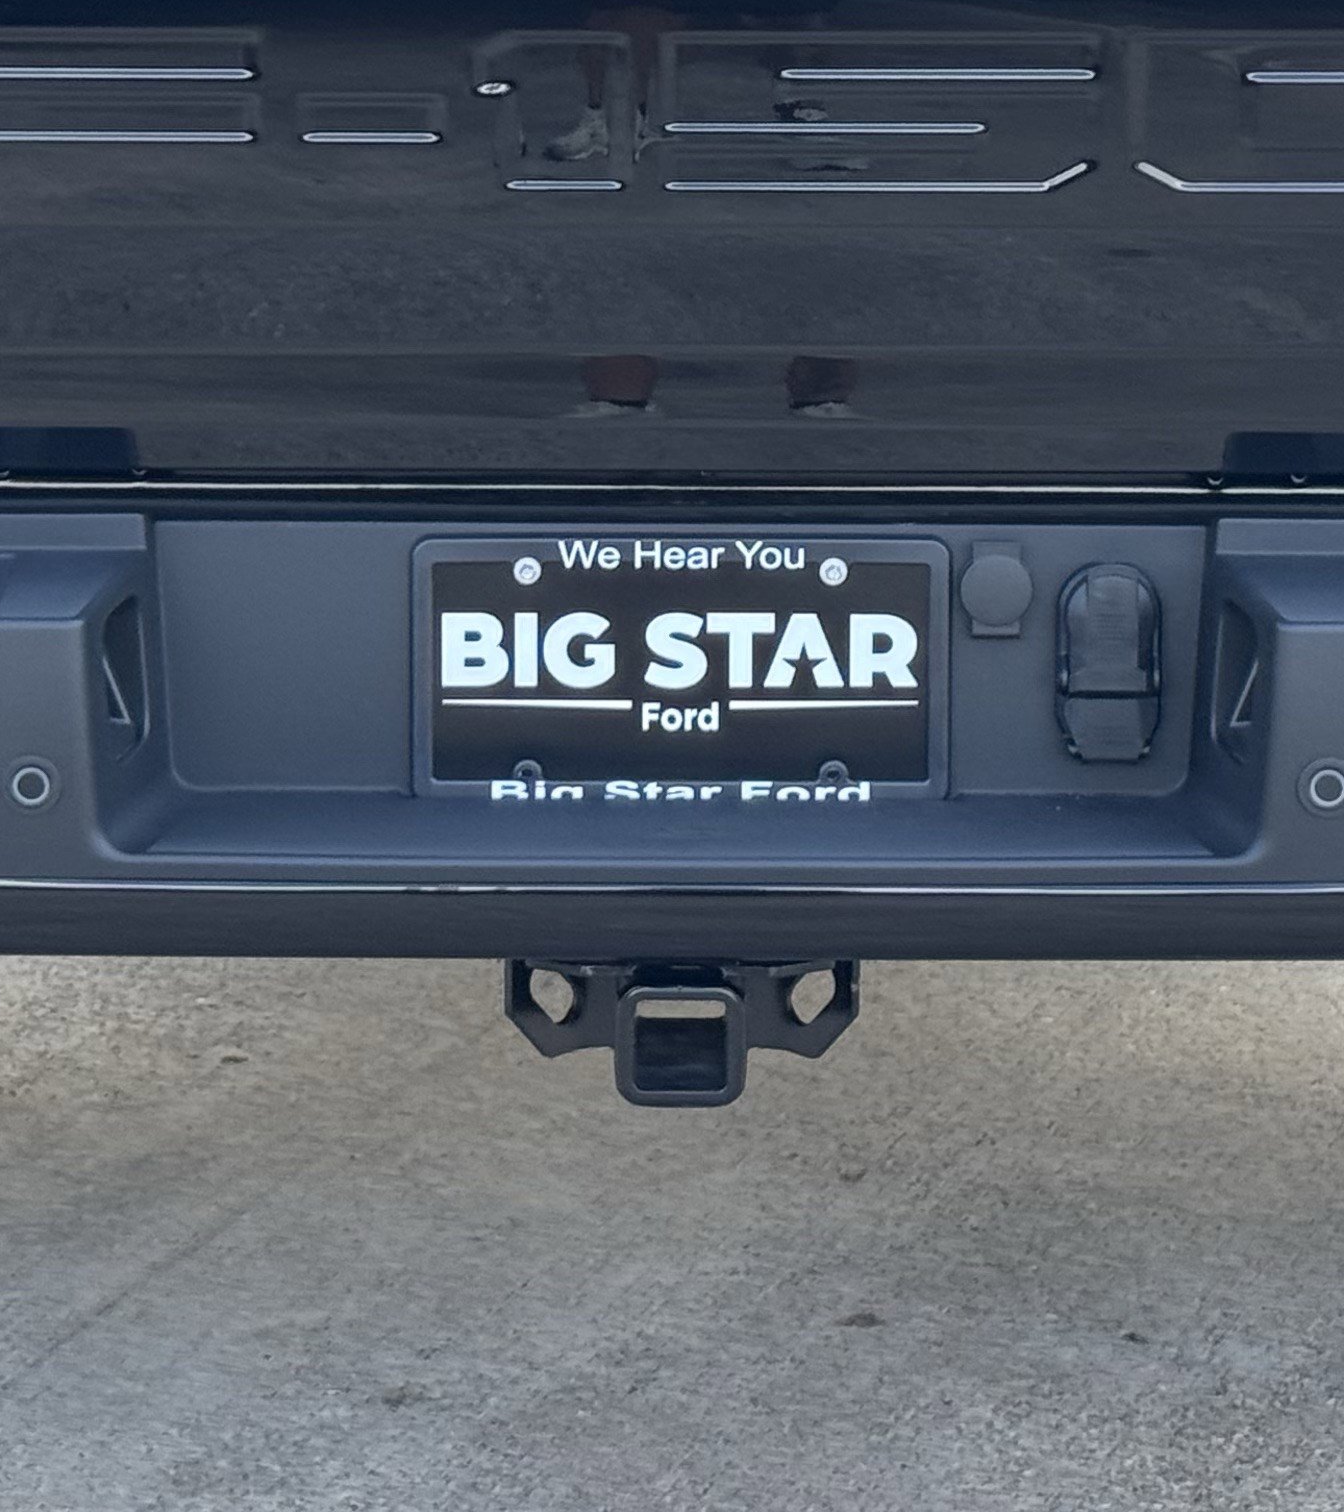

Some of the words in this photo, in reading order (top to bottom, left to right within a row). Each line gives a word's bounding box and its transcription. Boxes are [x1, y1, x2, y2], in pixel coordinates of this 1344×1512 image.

[558, 539, 622, 570] We
[634, 539, 725, 570] Hear
[735, 539, 806, 571] You
[441, 611, 616, 689] BIG
[643, 611, 919, 690] STAR
[641, 700, 721, 733] Ford
